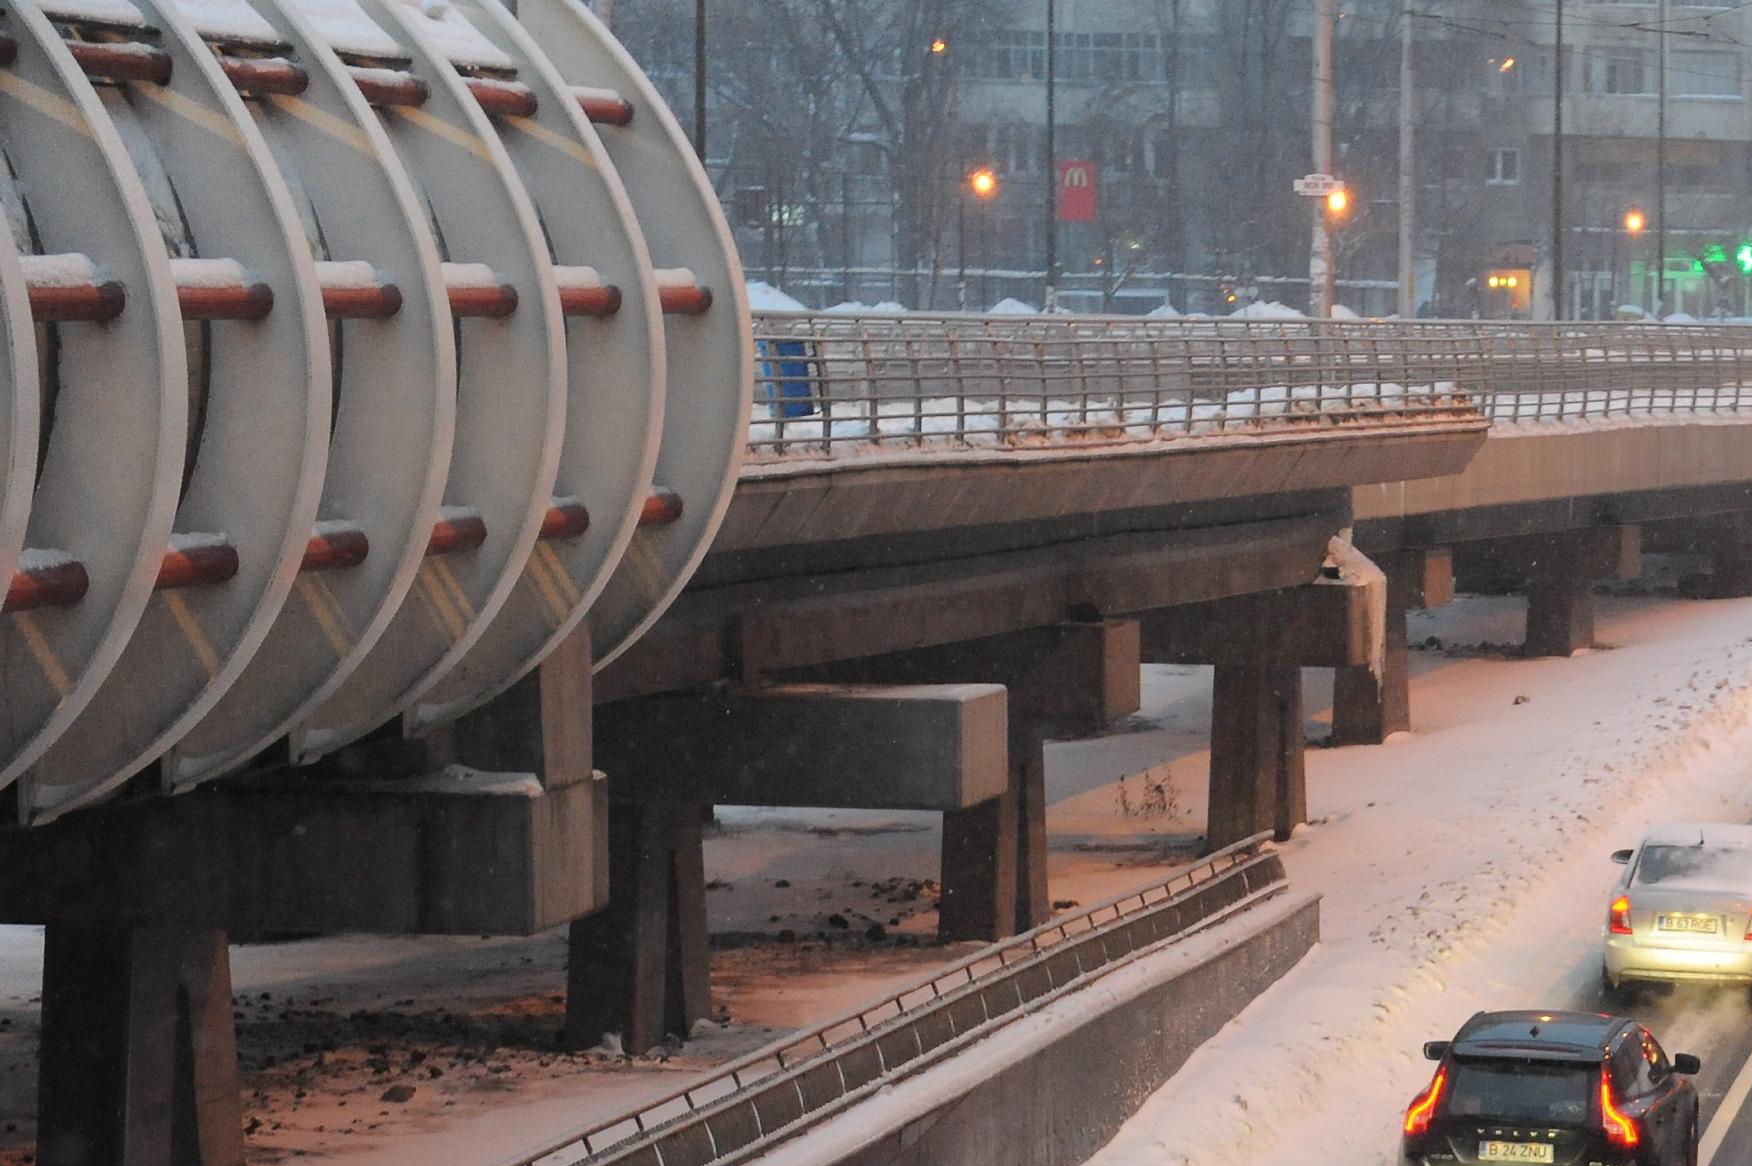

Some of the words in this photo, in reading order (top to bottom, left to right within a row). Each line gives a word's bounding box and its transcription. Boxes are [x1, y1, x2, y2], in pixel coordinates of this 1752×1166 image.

[1489, 1143, 1498, 1156] B
[1502, 1144, 1516, 1157] 24
[1520, 1145, 1547, 1158] ZNU
